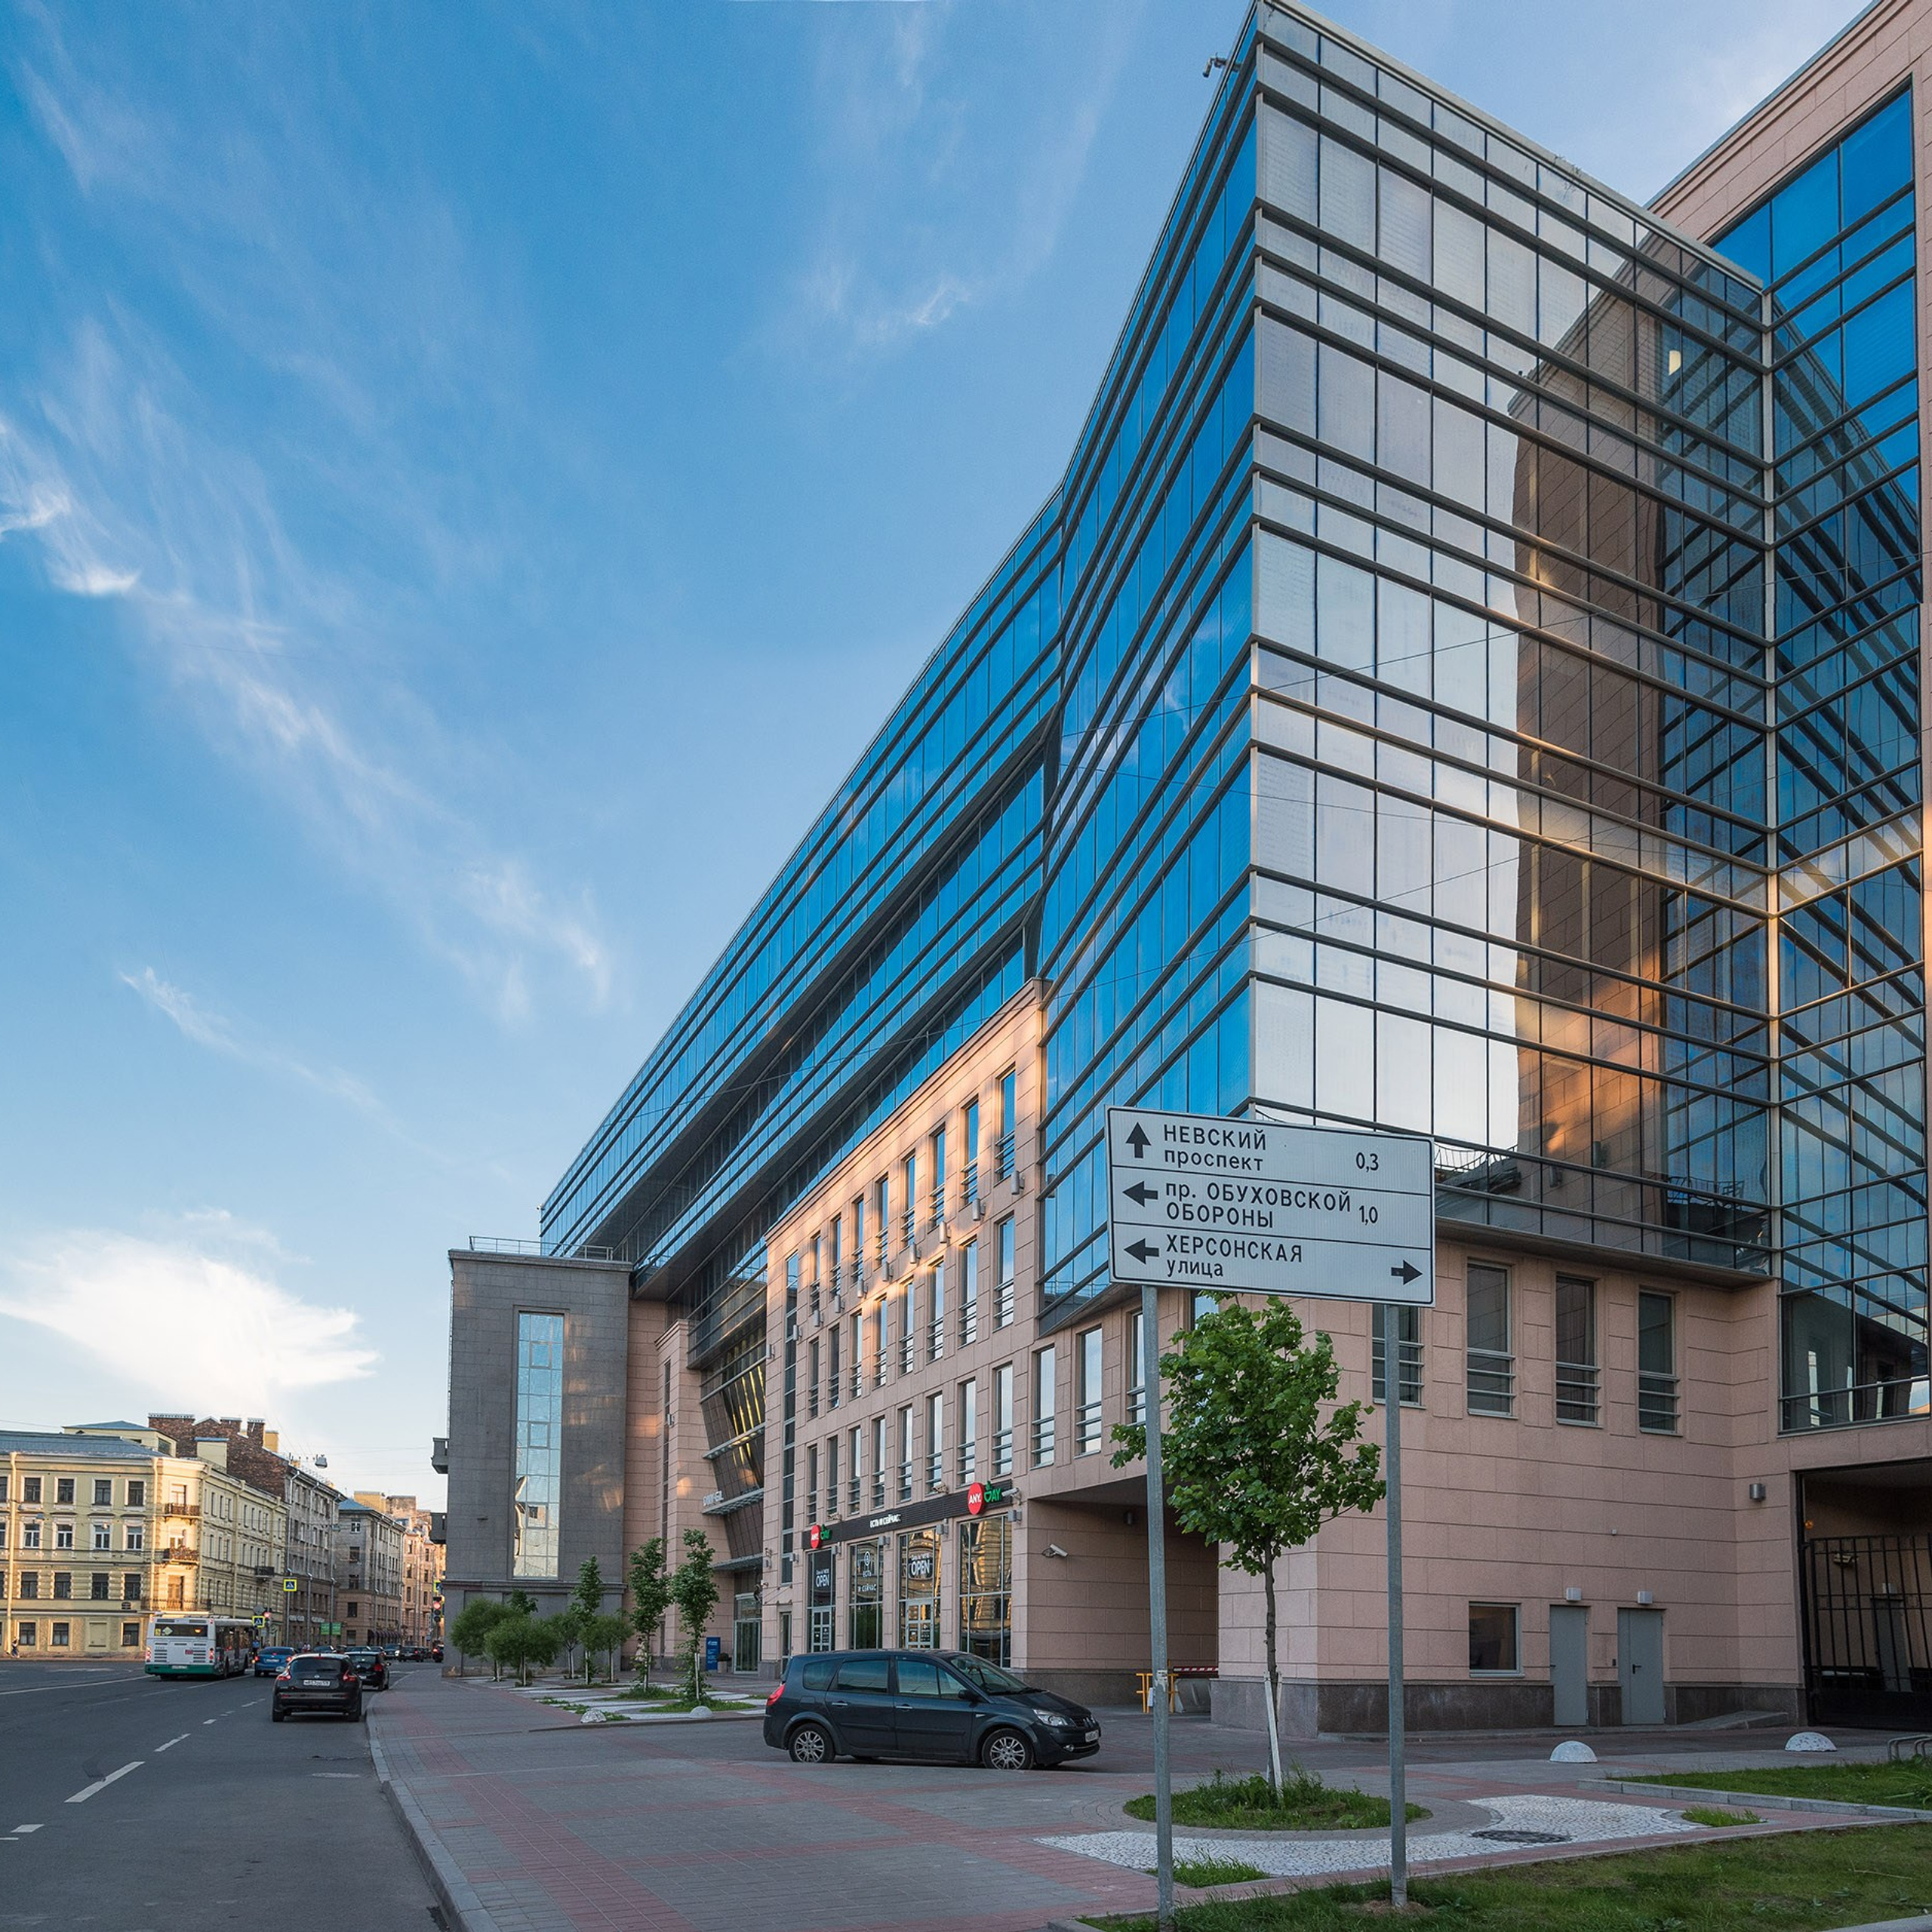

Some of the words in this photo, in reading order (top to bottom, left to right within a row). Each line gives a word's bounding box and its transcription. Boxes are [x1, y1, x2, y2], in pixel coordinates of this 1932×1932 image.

[1164, 1124, 1266, 1151] НЕВСКИЙ
[1164, 1149, 1263, 1171] проспект
[1355, 1152, 1380, 1173] 0,3
[1165, 1183, 1196, 1202] пр.
[1207, 1182, 1351, 1213] ОБУХОВСКОЙ
[1166, 1201, 1273, 1229] ОБОРОНЫ
[1358, 1204, 1379, 1226] 1,0
[1166, 1233, 1302, 1263] ХЕРСОНСКАЯ
[1166, 1259, 1224, 1279] улица
[911, 1559, 930, 1576] OPEN
[816, 1574, 829, 1588] OPEN
